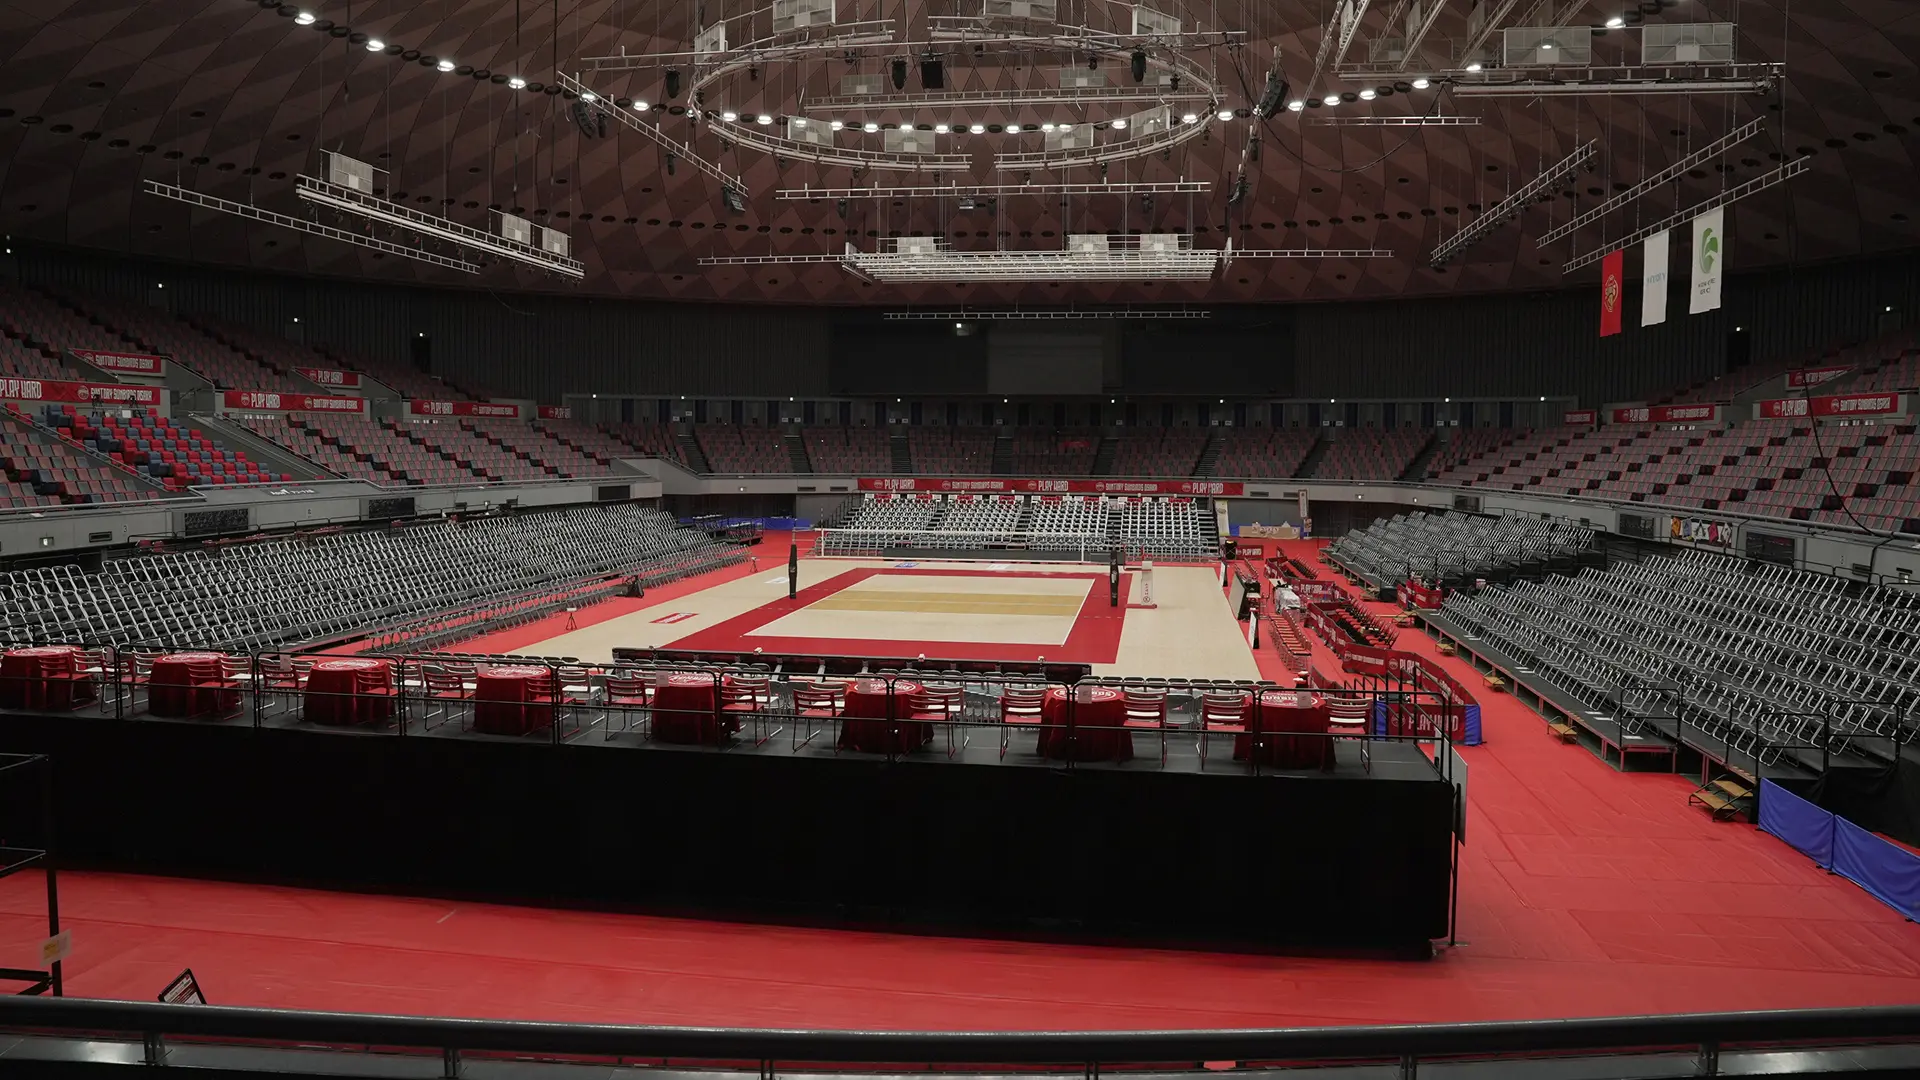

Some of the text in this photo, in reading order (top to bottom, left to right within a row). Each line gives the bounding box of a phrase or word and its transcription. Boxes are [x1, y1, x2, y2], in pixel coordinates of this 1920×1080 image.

[20, 381, 42, 399] HARD
[884, 479, 900, 490] PLAY
[1038, 480, 1053, 491] PLAY
[1192, 482, 1208, 493] PLAY
